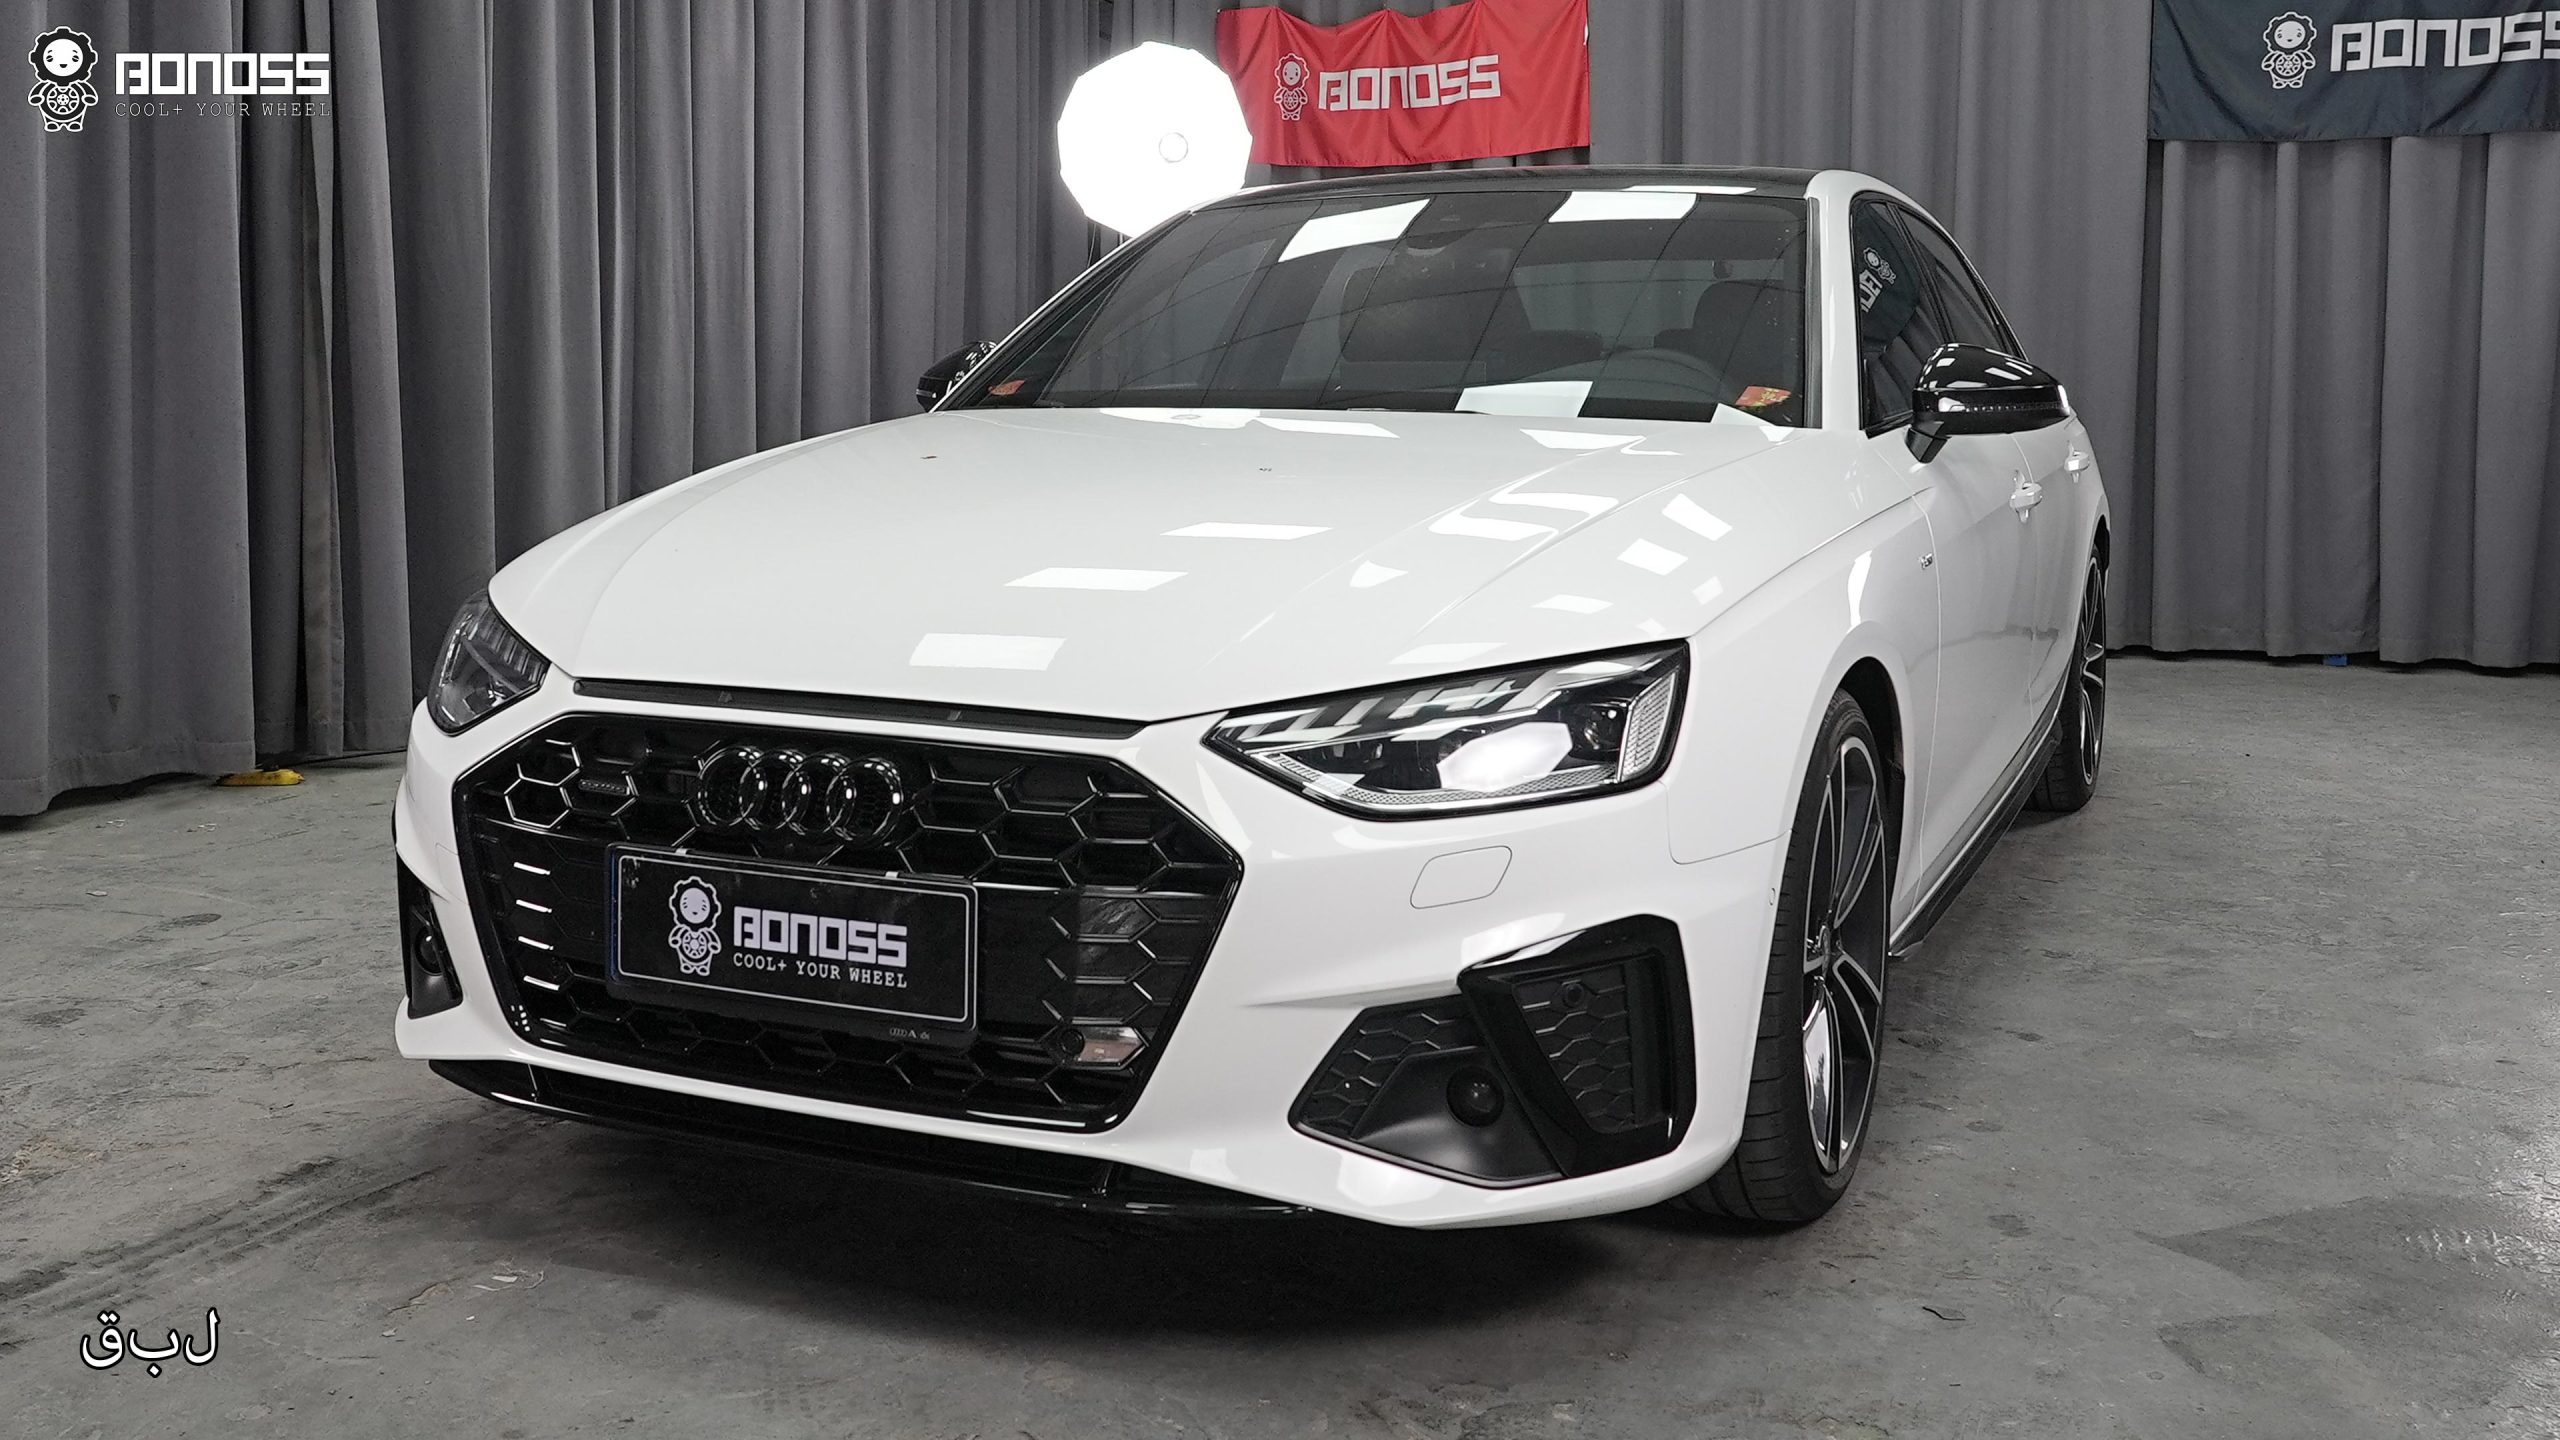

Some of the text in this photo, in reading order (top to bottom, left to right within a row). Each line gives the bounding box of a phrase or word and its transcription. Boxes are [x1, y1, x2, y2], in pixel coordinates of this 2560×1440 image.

[1318, 54, 1501, 112] BONOSS
[733, 906, 908, 968] BONOSS
[733, 952, 907, 988] COOL+ YOUR WHEEL
